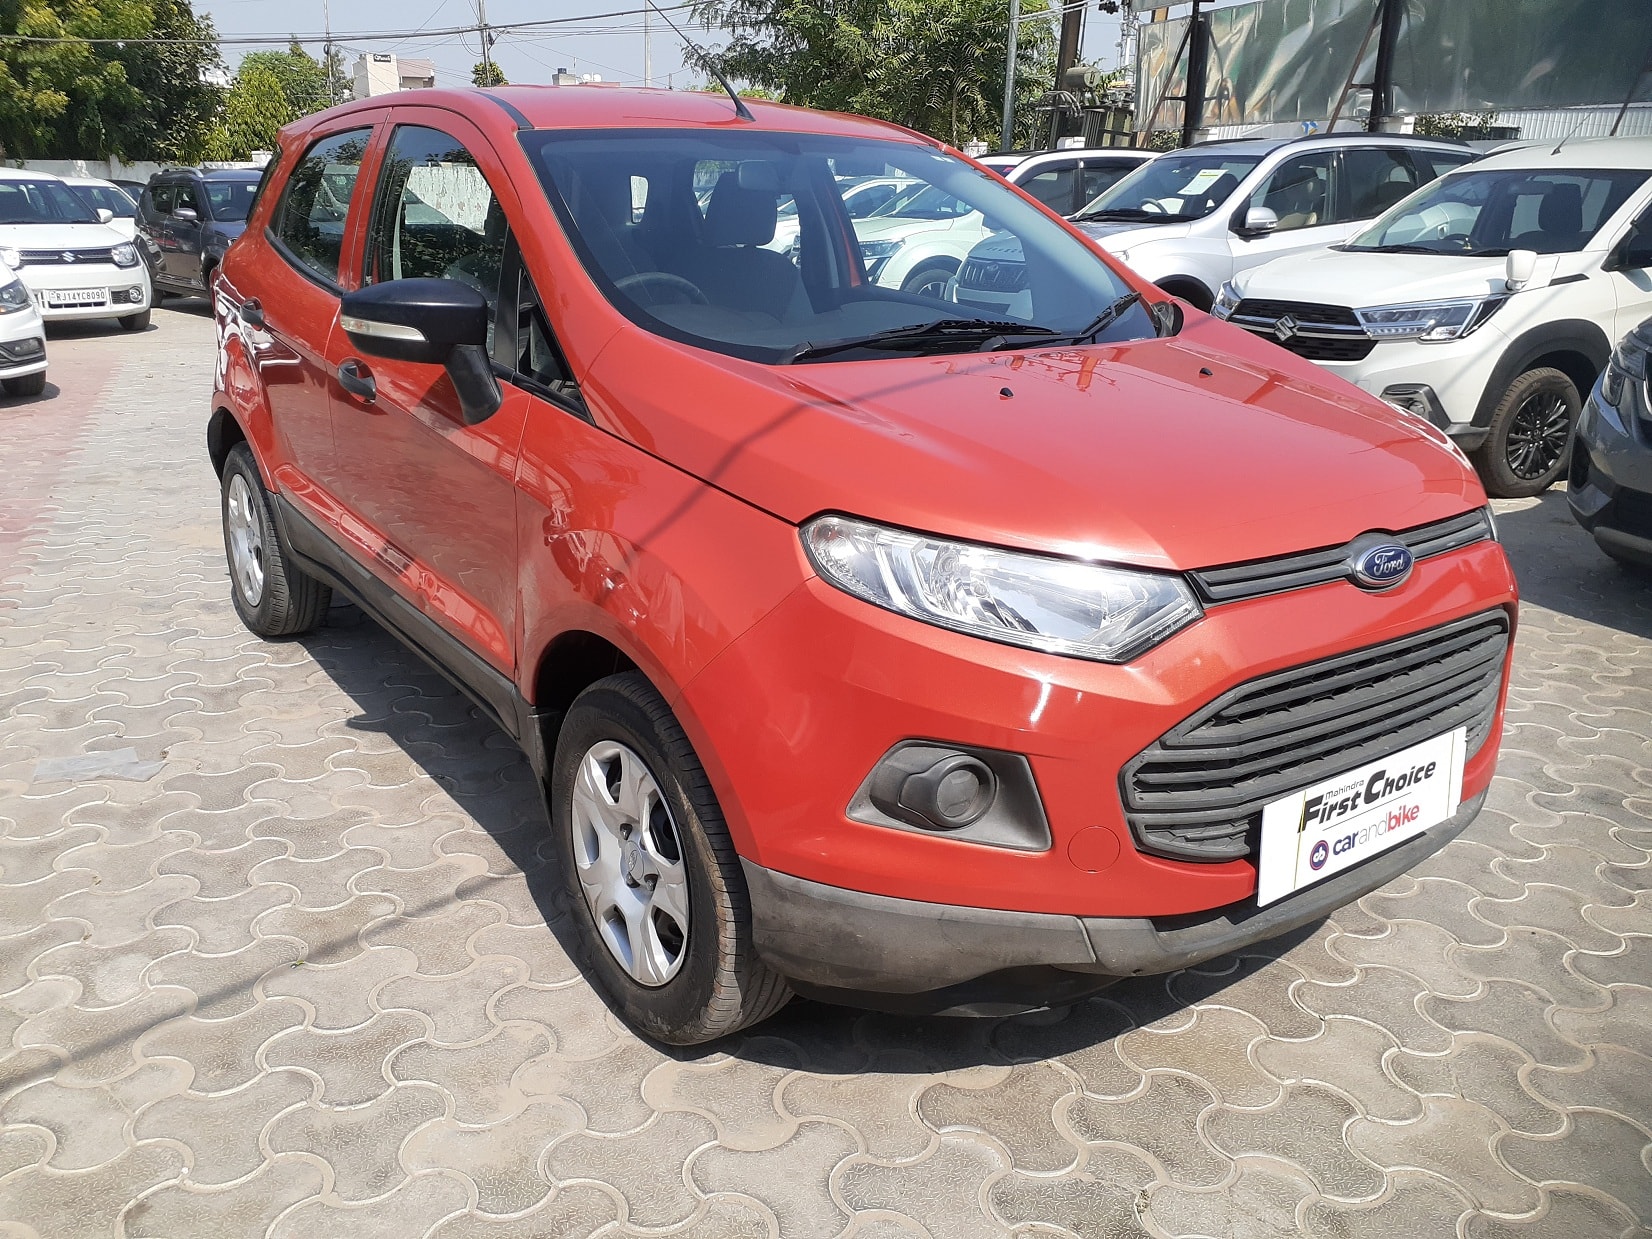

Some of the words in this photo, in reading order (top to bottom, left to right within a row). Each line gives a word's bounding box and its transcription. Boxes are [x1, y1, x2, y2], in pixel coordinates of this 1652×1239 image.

[56, 290, 105, 301] RJ14YC8090
[1373, 551, 1405, 576] Ford
[1363, 761, 1437, 805] Choice
[1332, 804, 1420, 856] carandbike
